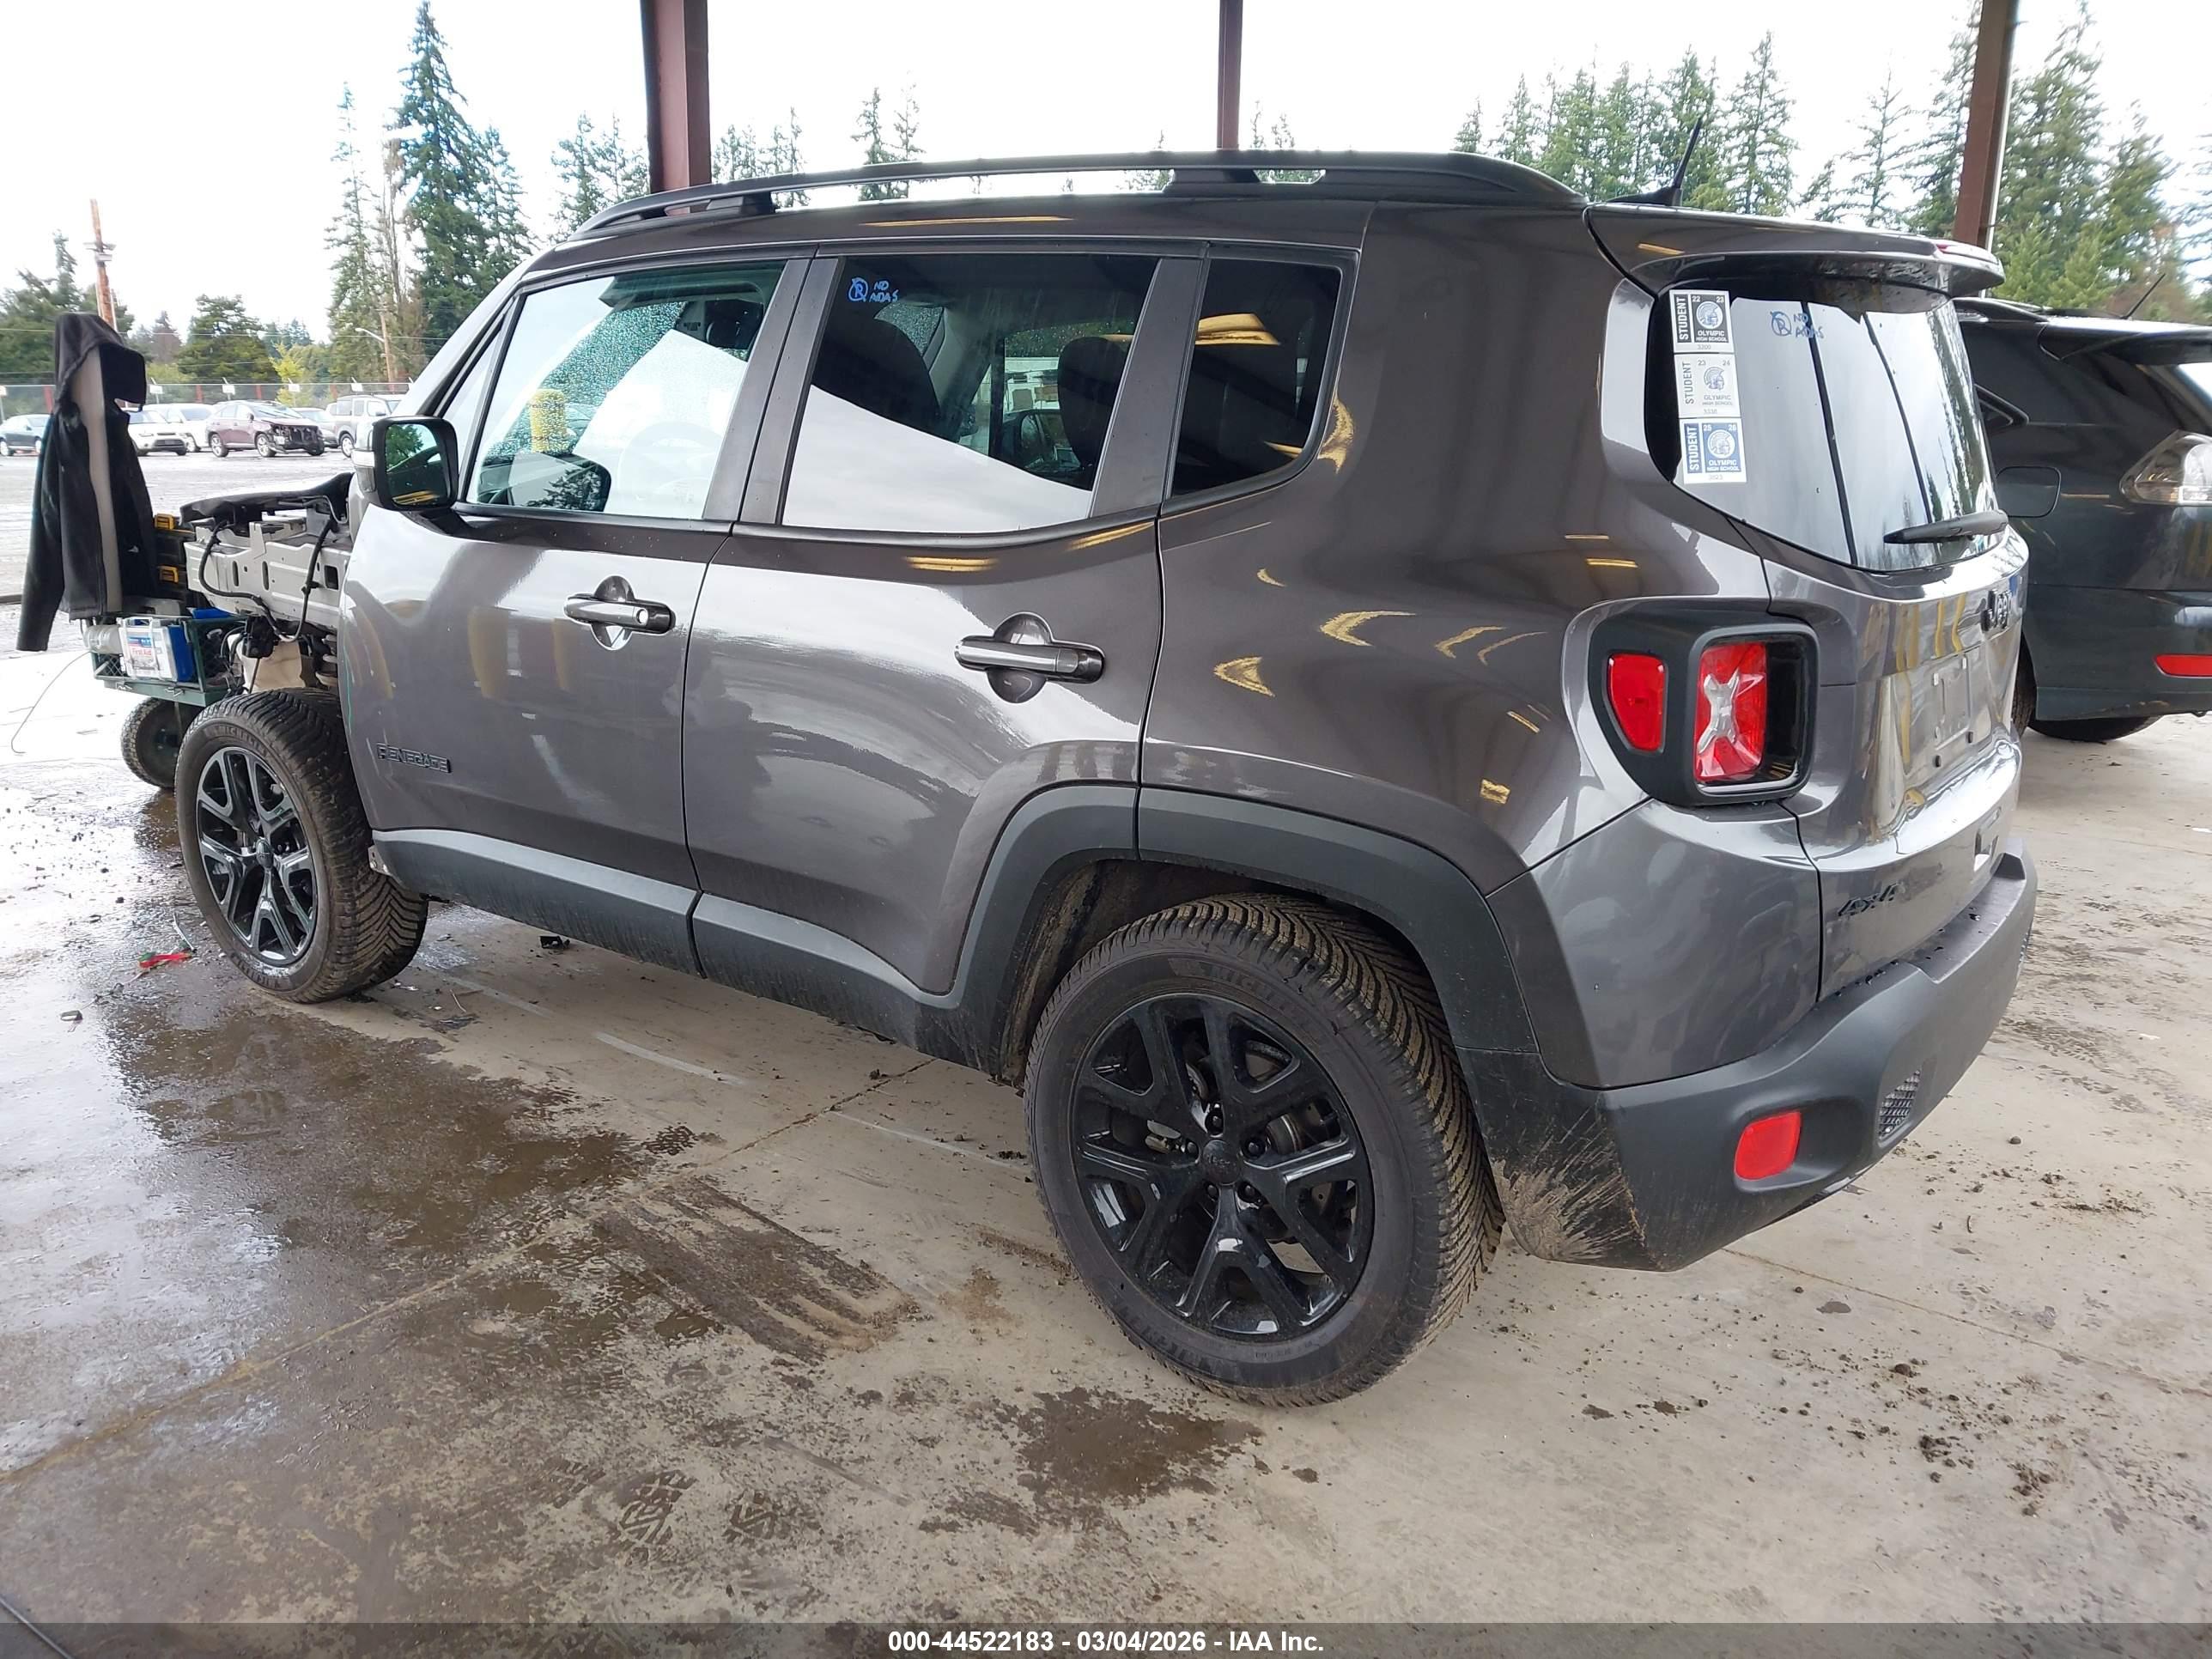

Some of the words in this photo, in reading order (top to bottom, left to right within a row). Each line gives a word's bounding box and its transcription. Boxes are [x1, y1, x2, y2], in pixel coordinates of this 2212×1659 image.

[1676, 297, 1689, 340] STUDENT
[1682, 361, 1694, 404] STUDENT
[1686, 426, 1700, 471] STUDENT
[376, 742, 453, 774] RENEGADE
